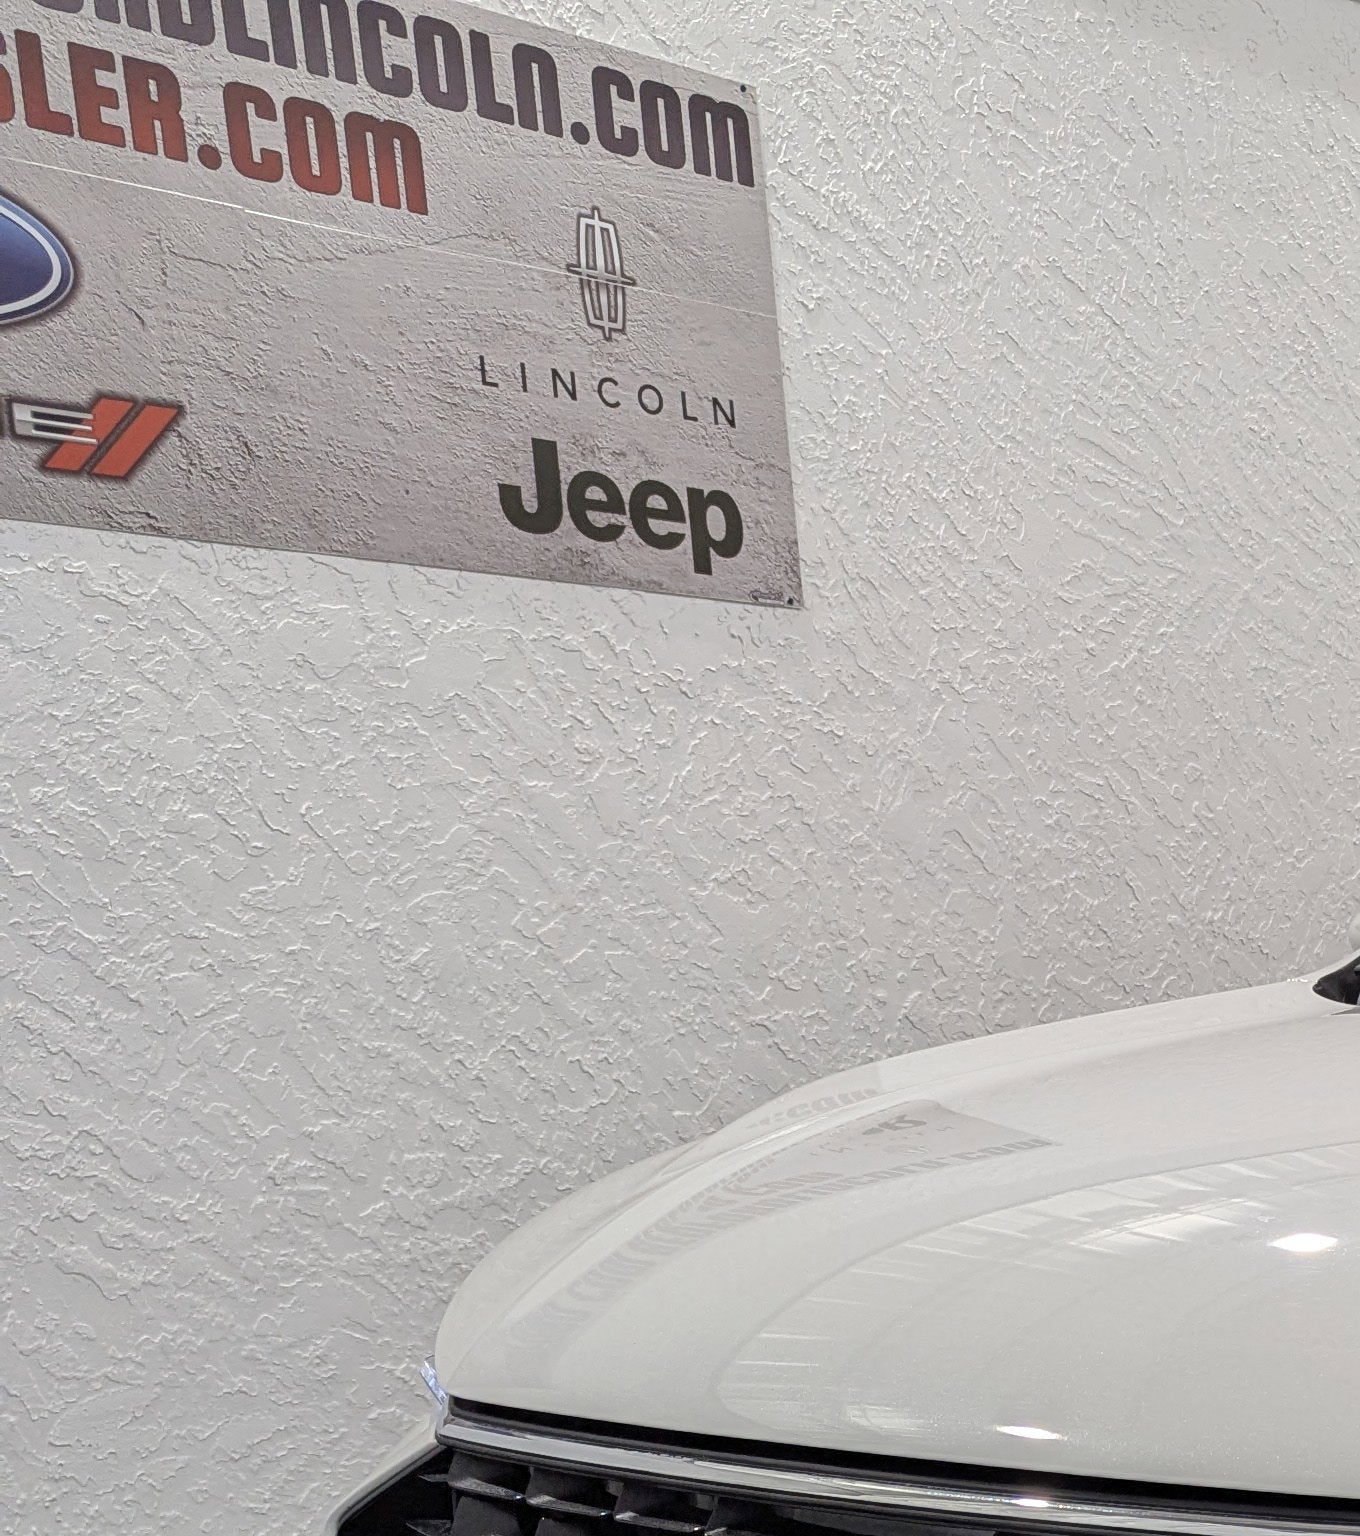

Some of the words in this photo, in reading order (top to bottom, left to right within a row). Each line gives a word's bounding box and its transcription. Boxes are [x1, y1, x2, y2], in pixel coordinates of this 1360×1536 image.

[0, 29, 428, 215] LER.COM
[479, 355, 736, 428] LINCOLN
[497, 437, 744, 576] Jeep
